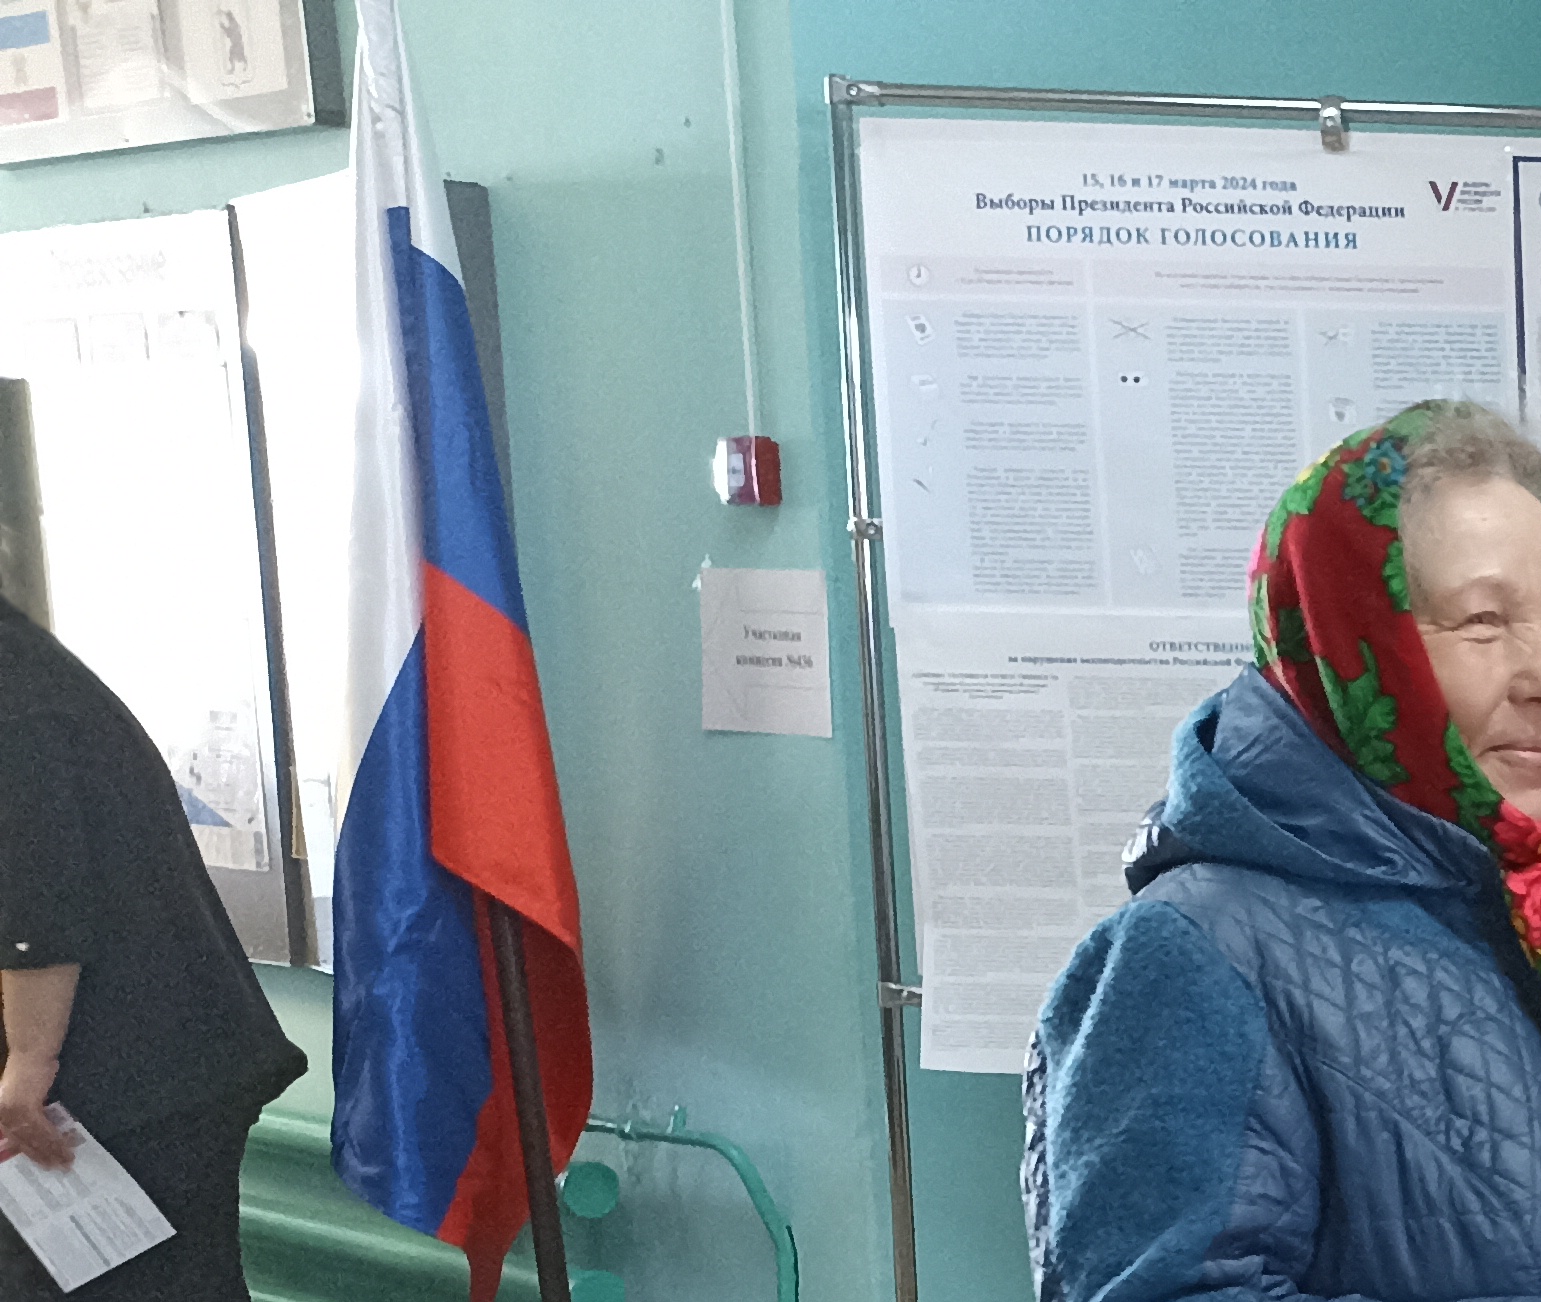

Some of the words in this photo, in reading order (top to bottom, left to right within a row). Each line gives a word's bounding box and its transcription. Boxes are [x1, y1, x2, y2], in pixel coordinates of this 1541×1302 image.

[1082, 173, 1104, 188] 15,
[1109, 174, 1127, 188] 16
[1148, 174, 1164, 188] 17
[1168, 178, 1217, 193] марта
[1221, 176, 1257, 191] 2024
[1261, 179, 1298, 192] года
[975, 193, 1055, 215] Выборы
[1061, 194, 1175, 216] Президента
[1181, 197, 1293, 216] Российской
[1298, 200, 1406, 222] Федерации
[1026, 225, 1150, 246] ПОРЯДОК
[1160, 227, 1358, 250] ГОЛОСОВАНИЯ
[1149, 640, 1253, 654] ОТВЕТСТВЕНН
